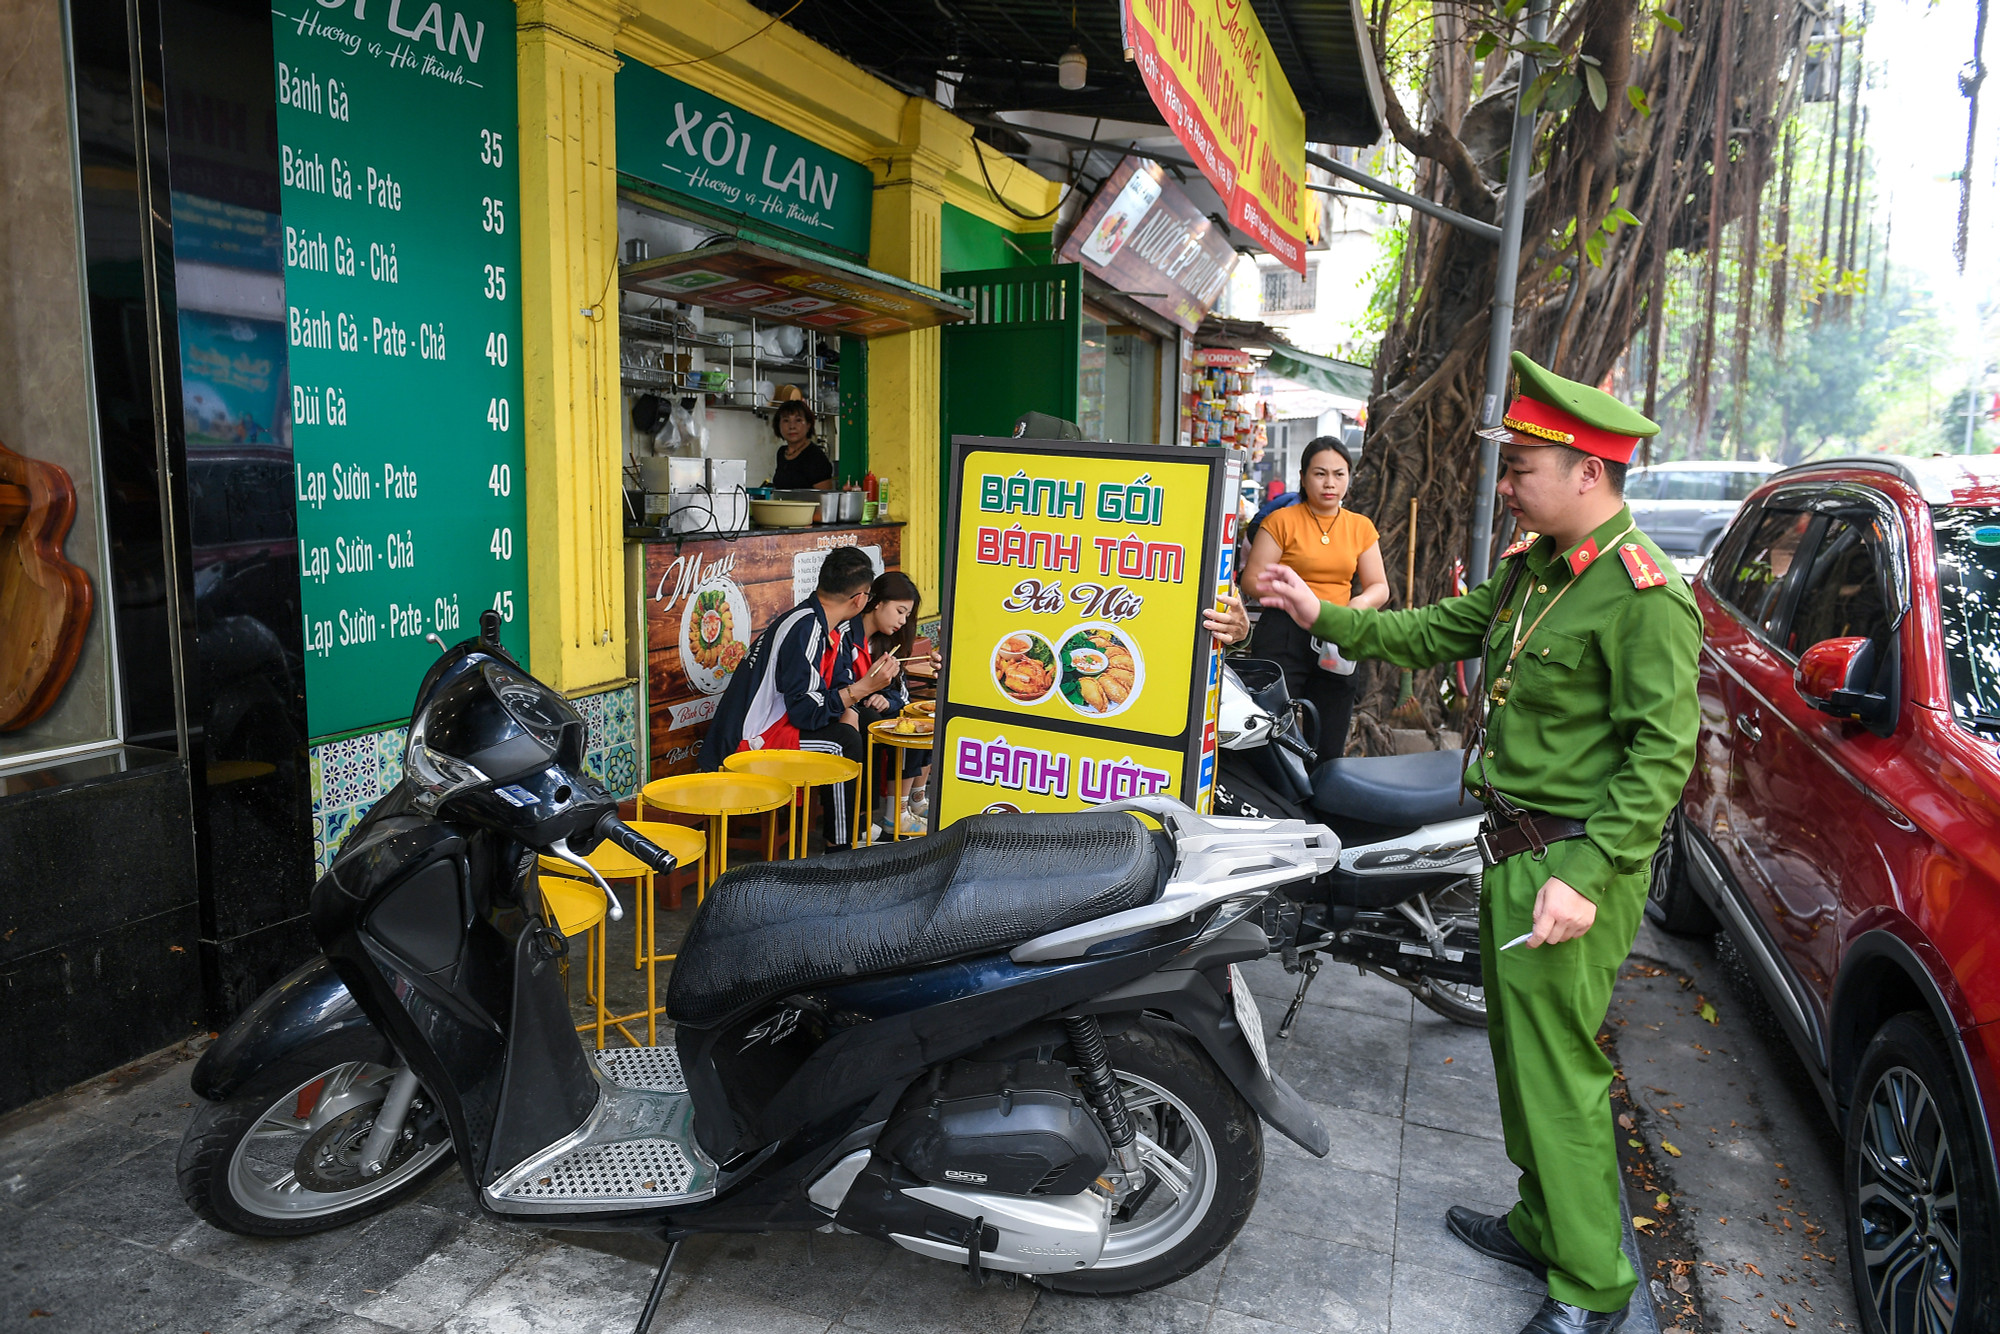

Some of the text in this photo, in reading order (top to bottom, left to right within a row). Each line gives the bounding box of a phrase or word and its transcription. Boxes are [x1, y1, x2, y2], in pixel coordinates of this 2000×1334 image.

[291, 8, 362, 56] Hương
[385, 43, 418, 70] Hà
[387, 0, 485, 63] LAN
[278, 62, 503, 169] Bánh Gà 35
[665, 101, 839, 211] XÔI LAN
[282, 145, 325, 195] Bánh
[331, 157, 352, 200] Gà
[367, 166, 402, 212] Pate
[482, 196, 504, 235] 35
[683, 166, 741, 204] Hương
[758, 197, 784, 215] Hà
[285, 226, 329, 273] Bánh
[334, 235, 355, 278] Gà
[370, 243, 398, 284] Chả
[484, 264, 507, 302] 35
[1166, 231, 1205, 280] ÉP
[289, 306, 332, 350] Bánh
[337, 313, 358, 353] Gà
[373, 317, 406, 357] Pate
[420, 322, 446, 361] Chả
[485, 332, 508, 367] 40
[1207, 353, 1243, 364] ORION
[293, 385, 510, 432] Đùi Gà 40
[297, 463, 326, 510] Lạp
[333, 462, 370, 501] Sườn
[385, 463, 417, 499] Pate
[488, 464, 511, 498] 40
[979, 469, 1164, 526] BÁNH GỐI
[301, 539, 330, 584] Lạp
[336, 536, 373, 575] Sườn
[387, 530, 414, 570] Chả
[489, 528, 513, 561] 40
[655, 551, 737, 613] Menu
[975, 522, 1186, 585] BÁNH TÔM
[305, 615, 333, 657] Lạp
[339, 607, 376, 647] Sườn
[390, 604, 422, 638] Pate
[435, 593, 460, 632] Chả
[492, 590, 514, 623] 45
[1003, 578, 1145, 623] Hà Nội
[956, 735, 1171, 804] BÁNH ƯỚT
[1017, 1243, 1081, 1257] HONDA
